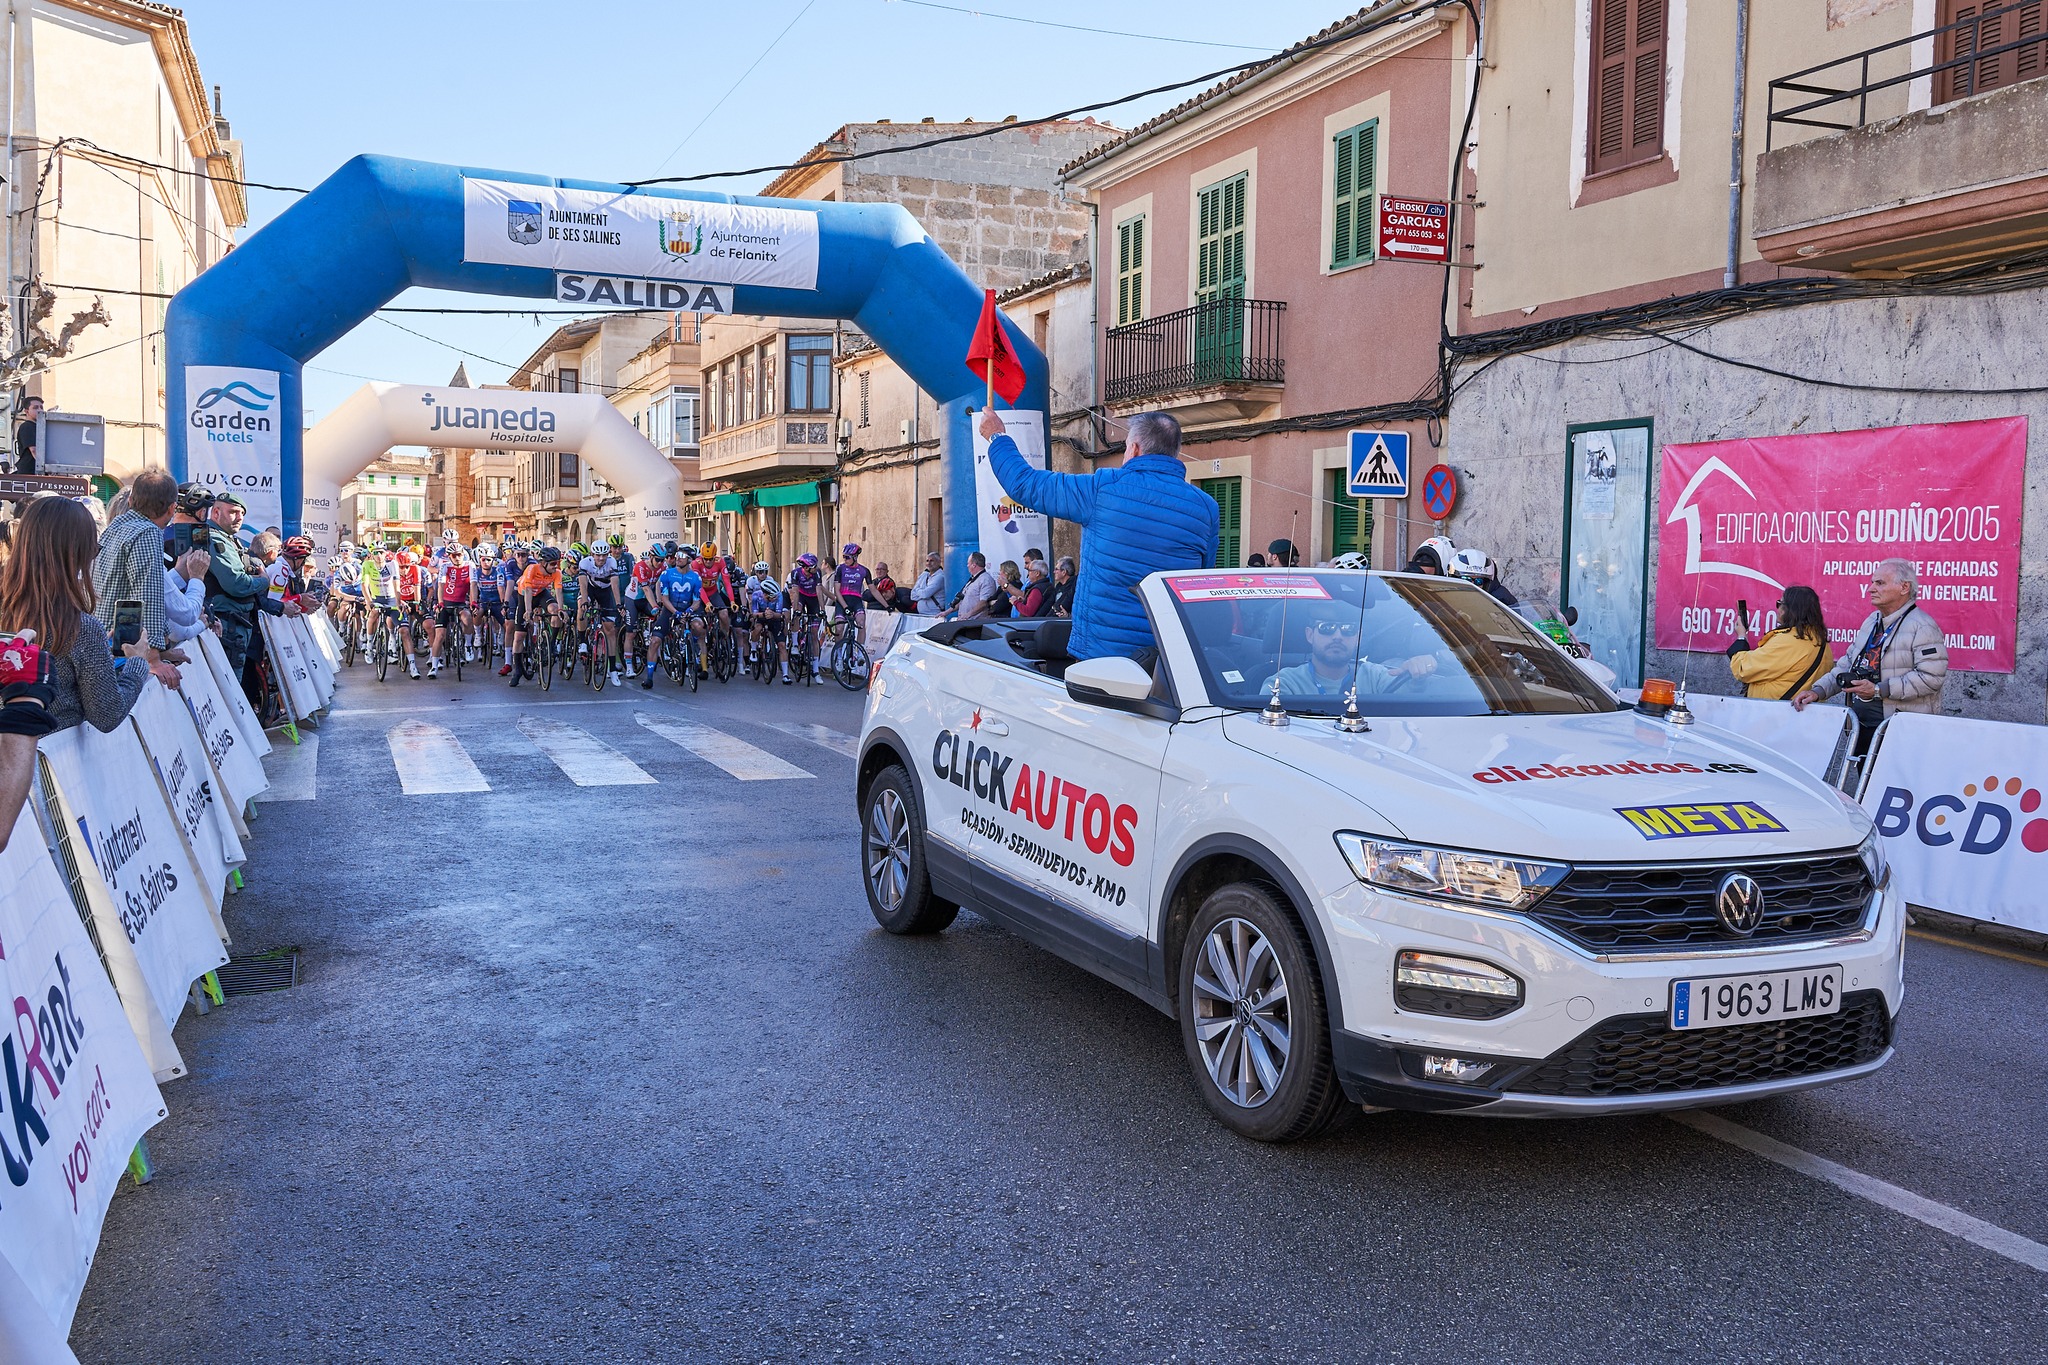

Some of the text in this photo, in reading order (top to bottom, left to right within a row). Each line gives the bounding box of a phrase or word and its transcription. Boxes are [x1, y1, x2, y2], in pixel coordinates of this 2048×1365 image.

[1395, 202, 1443, 214] EROSKI city
[549, 210, 608, 226] AJUNTAMENT
[1387, 214, 1441, 228] GARCIAS
[549, 226, 621, 245] DE SES SALINES
[711, 230, 780, 246] Ajuntament
[1395, 228, 1407, 236] 971
[1408, 229, 1420, 238] 655
[1420, 230, 1432, 239] 053
[1437, 231, 1445, 240] 56
[710, 246, 777, 262] de Felanitx
[1410, 244, 1420, 252] 170
[561, 275, 724, 313] SALIDA
[190, 409, 270, 432] Garden
[430, 405, 556, 433] juaneda
[207, 429, 254, 443] hotels
[490, 431, 554, 444] Hospitales
[195, 472, 273, 487] LUXCOM
[646, 508, 677, 518] juaneda
[1715, 501, 2000, 543] EDIFICACIONES GUDIÑO2005
[647, 531, 679, 541] juaneda
[1926, 560, 1999, 577] FACHADAS
[1859, 583, 1997, 602] Y EN GENERAL
[1681, 606, 1711, 634] 690
[1715, 608, 1736, 636] 73
[1472, 759, 1758, 784] clickautos.es
[932, 729, 1138, 867] CLICKAUTOS
[1620, 804, 1782, 836] META
[1874, 786, 2013, 855] BCD
[961, 807, 1004, 844] OCASIÓN
[1007, 832, 1087, 886] SEMINUEVOS
[1678, 974, 1834, 1021] E 1963 LMS
